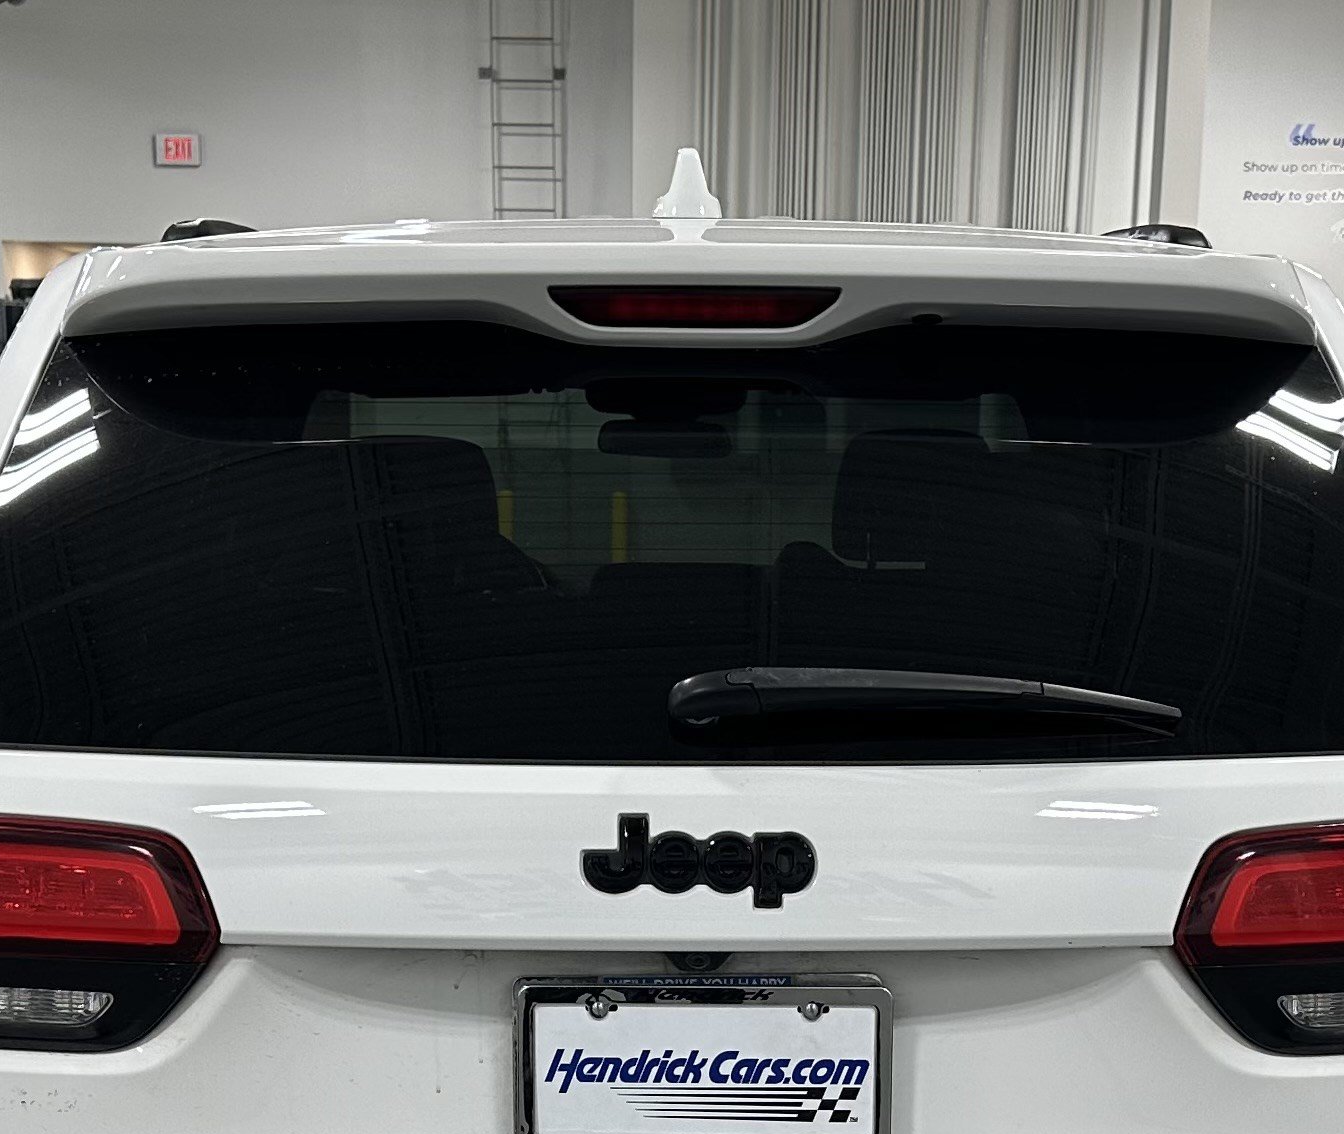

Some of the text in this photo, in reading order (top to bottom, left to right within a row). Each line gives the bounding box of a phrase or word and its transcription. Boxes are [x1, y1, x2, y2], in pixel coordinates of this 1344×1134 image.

[1291, 135, 1331, 146] Show
[164, 137, 193, 161] EXIT
[1243, 161, 1279, 173] Show
[1281, 163, 1298, 175] up
[1301, 163, 1318, 173] on
[1242, 190, 1285, 203] Ready
[1288, 191, 1302, 201] to
[1305, 191, 1327, 203] get
[579, 812, 818, 909] Jeep
